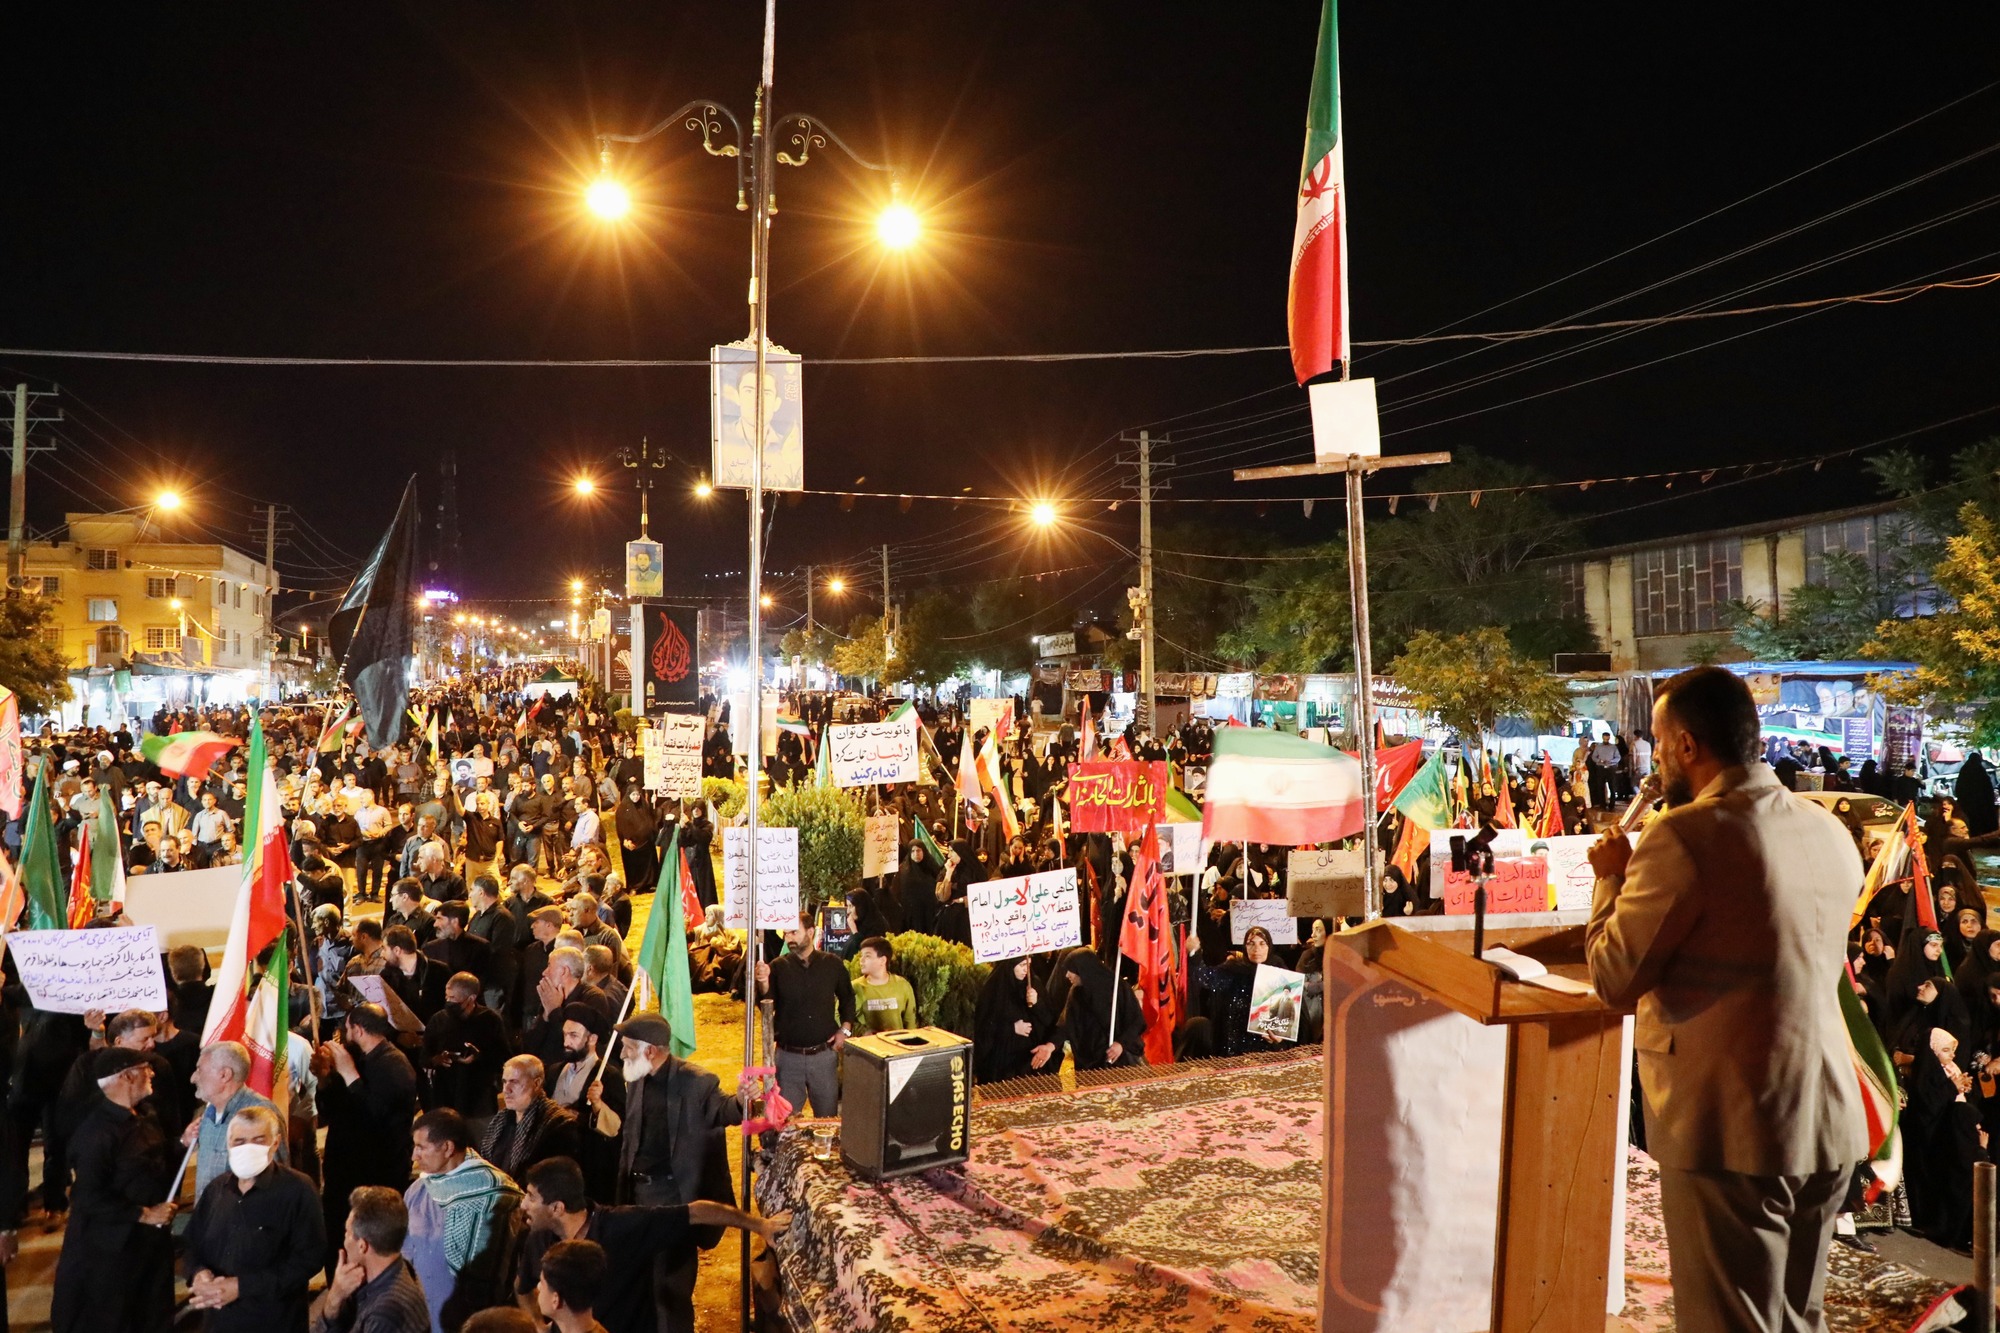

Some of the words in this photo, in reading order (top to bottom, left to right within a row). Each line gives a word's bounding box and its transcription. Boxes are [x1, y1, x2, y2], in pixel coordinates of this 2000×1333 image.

[670, 721, 679, 731] بر
[902, 745, 913, 762] از
[850, 766, 873, 784] کنید
[871, 763, 900, 782] اقدام
[1052, 875, 1075, 899] گاهی
[971, 890, 991, 914] امام
[1041, 903, 1056, 914] ۷۲
[1056, 900, 1073, 913] فقط
[1004, 908, 1027, 925] واقعی
[1028, 904, 1041, 922] یار
[1032, 918, 1048, 934] کجا
[1054, 930, 1079, 948] فردای
[981, 944, 1005, 958] است
[1005, 945, 1022, 958] دیر
